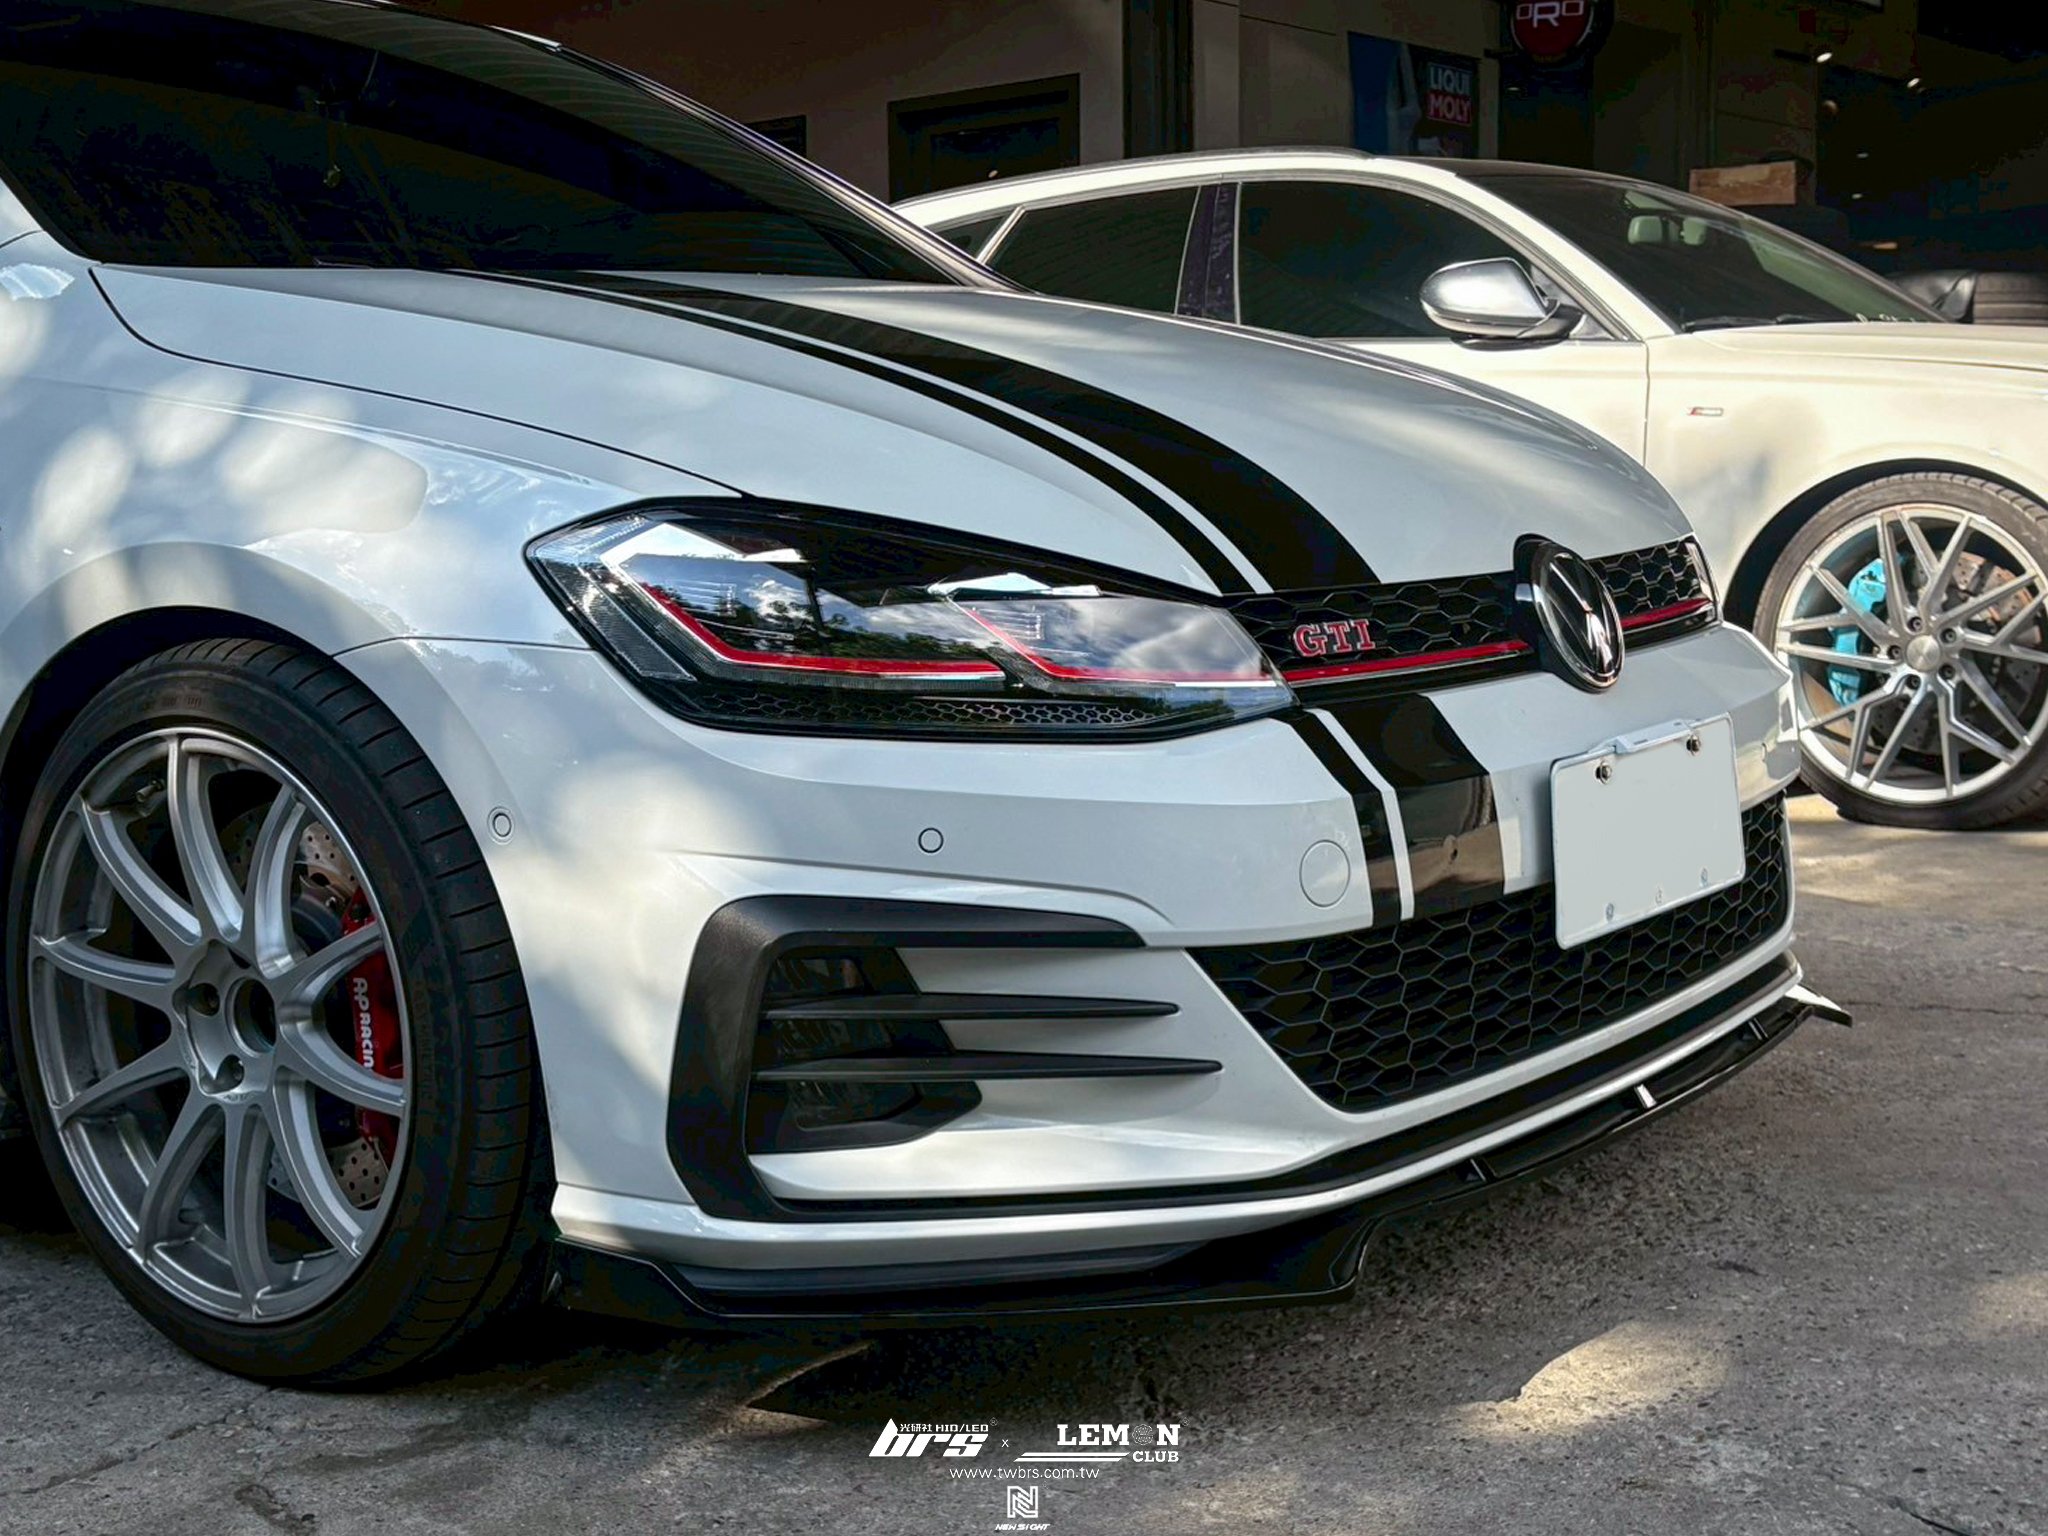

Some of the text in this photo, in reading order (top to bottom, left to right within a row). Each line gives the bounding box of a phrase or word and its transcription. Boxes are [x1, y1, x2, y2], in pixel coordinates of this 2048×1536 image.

[1430, 66, 1471, 94] LIQUI
[1429, 91, 1472, 122] MOLY
[1292, 618, 1376, 657] GTI
[360, 1012, 375, 1070] RACIN
